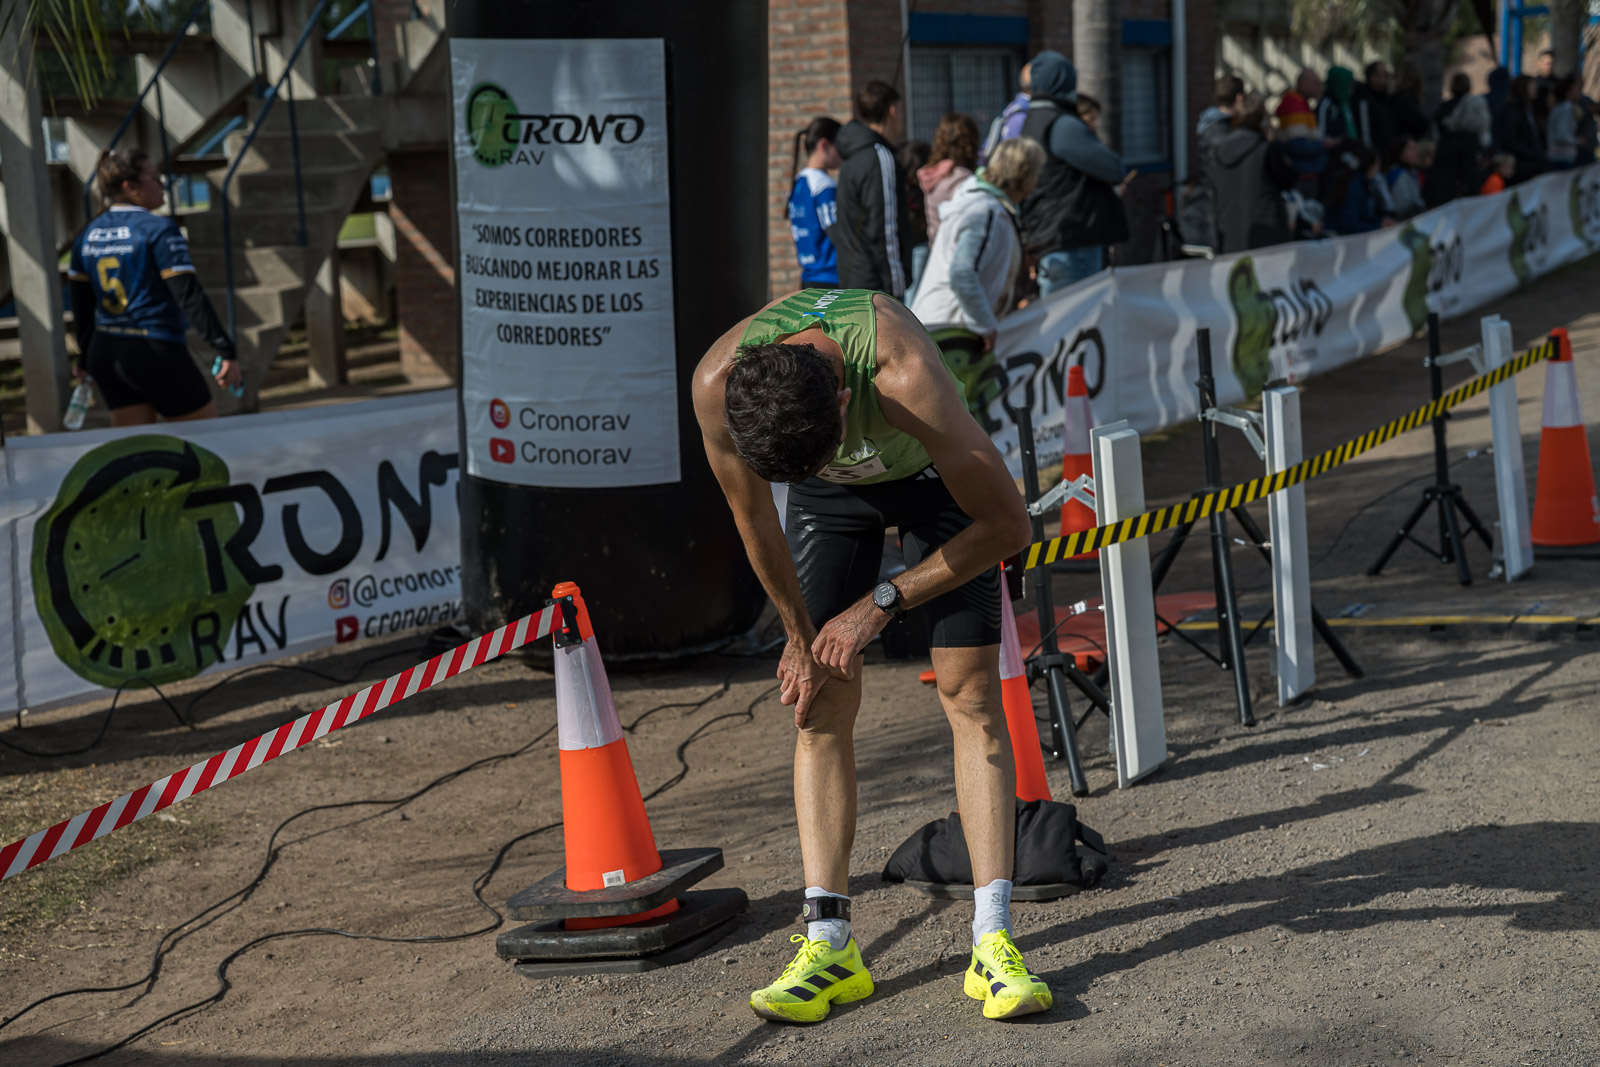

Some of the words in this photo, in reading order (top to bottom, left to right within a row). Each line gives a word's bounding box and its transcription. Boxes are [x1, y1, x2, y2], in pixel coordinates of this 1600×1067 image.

[502, 114, 645, 144] CRONO
[501, 150, 545, 165] RAV
[525, 226, 642, 248] CORREDORES
[466, 254, 532, 280] BUSCANDO
[537, 260, 622, 281] MEJORAR
[627, 259, 660, 279] LAS
[97, 257, 128, 314] 5
[475, 288, 577, 314] EXPERIENCIAS
[583, 294, 607, 314] DE
[611, 292, 643, 312] LOS
[497, 323, 611, 347] CORREDORES”
[519, 407, 630, 431] Cronorav
[521, 441, 632, 464] Cronorav
[191, 595, 290, 668] RAV
